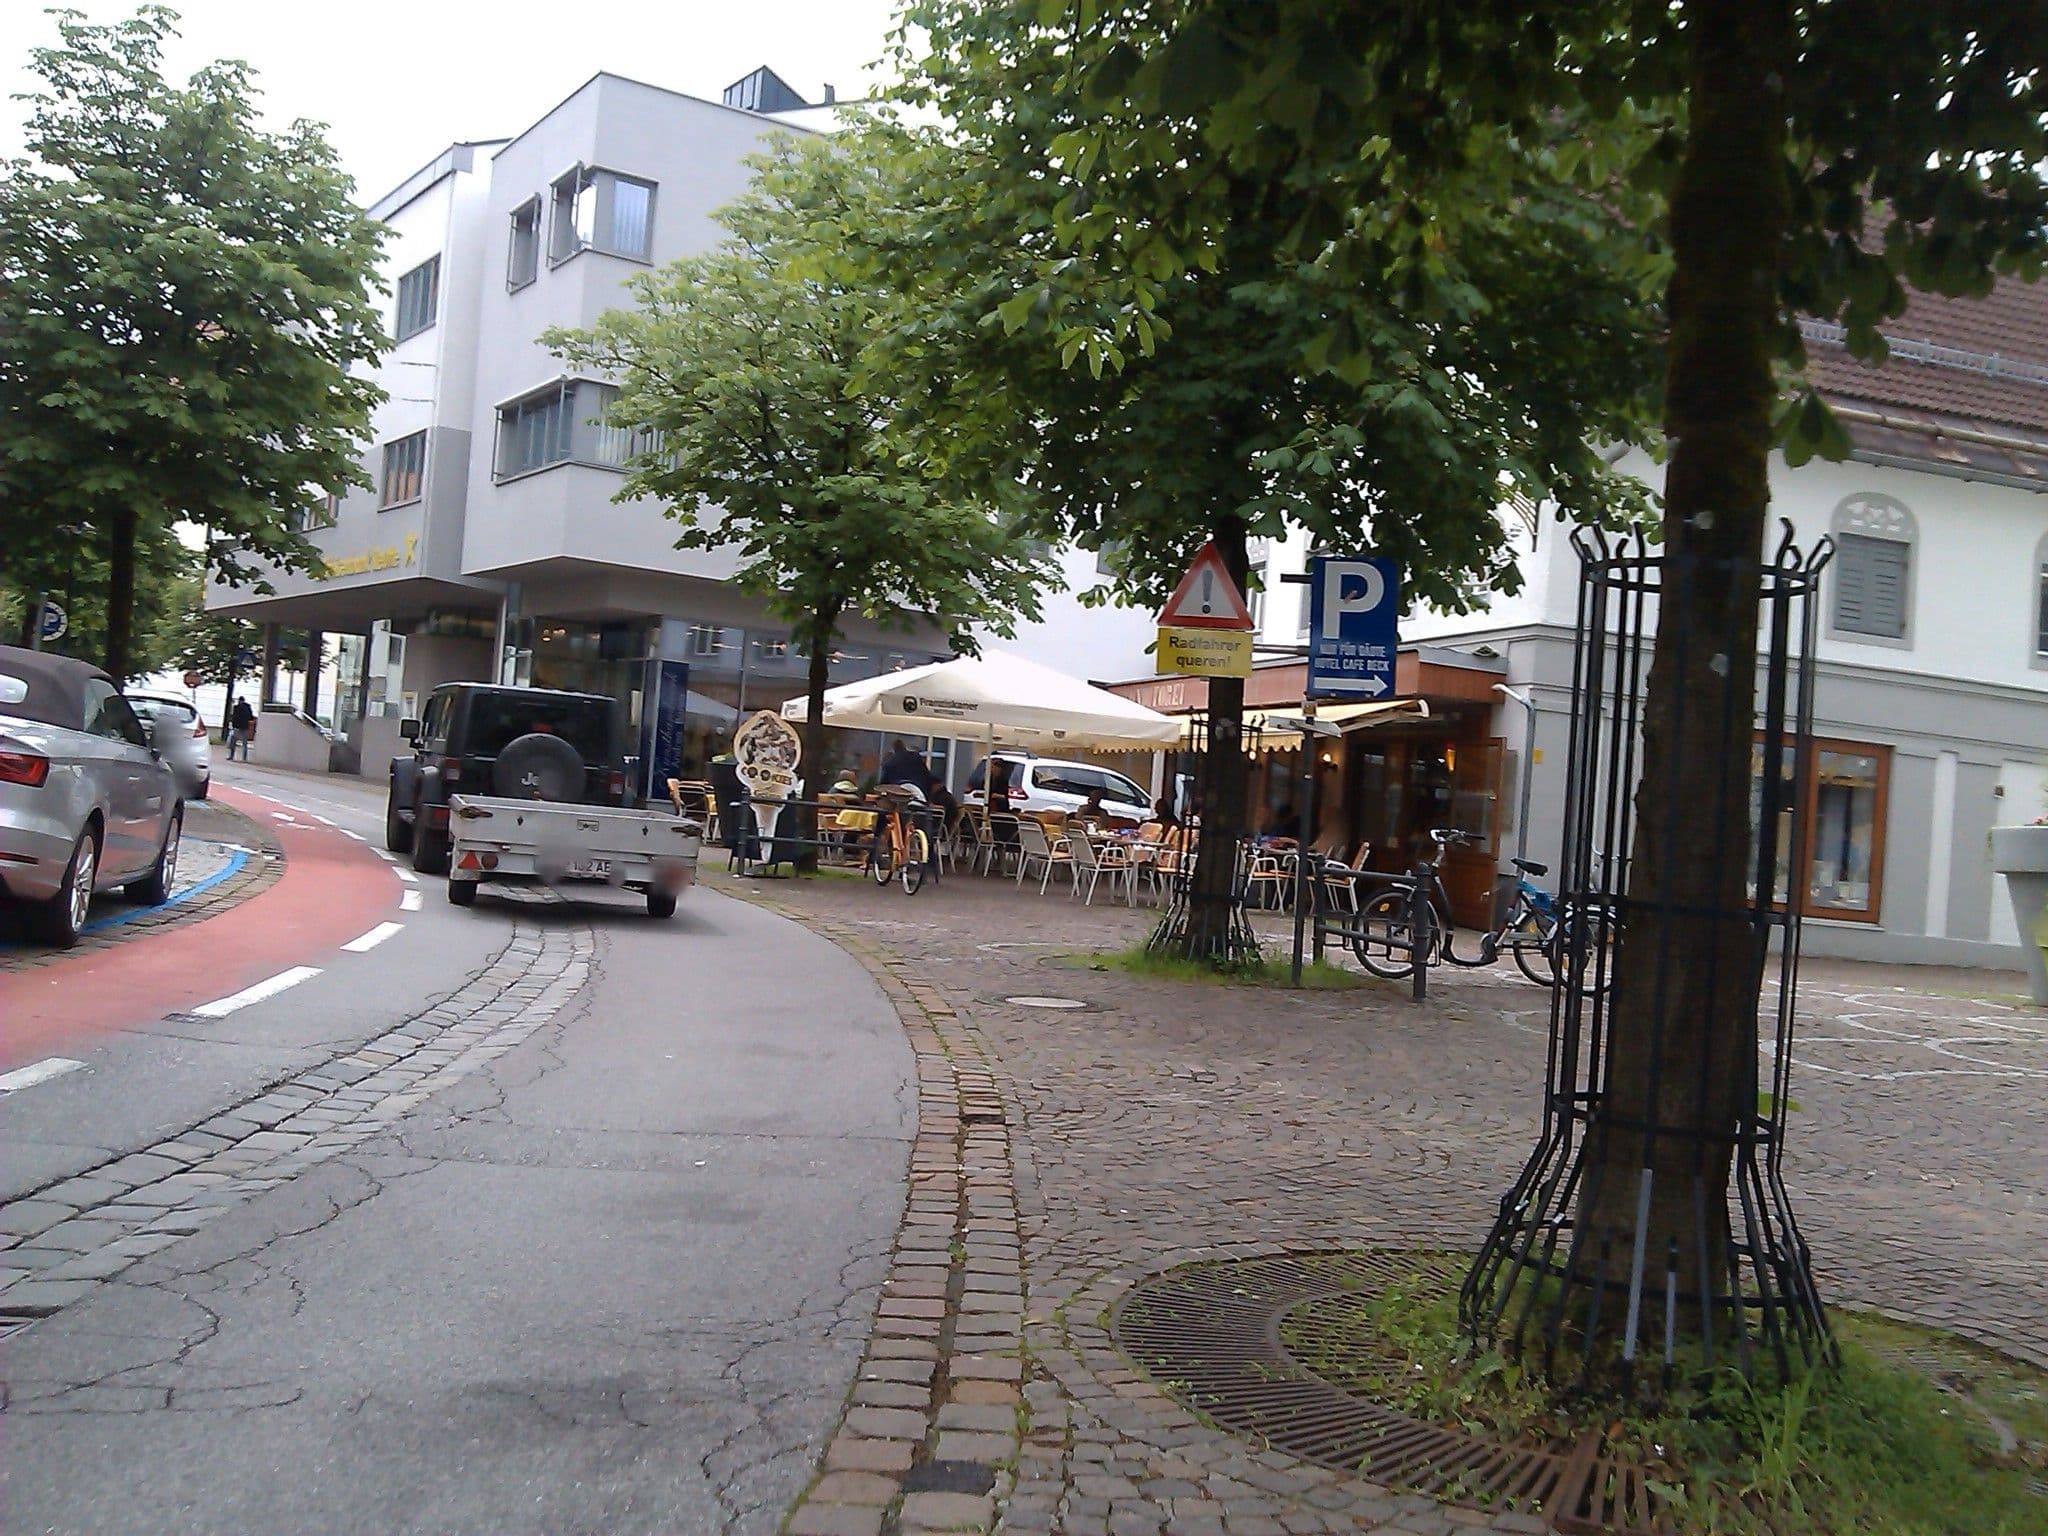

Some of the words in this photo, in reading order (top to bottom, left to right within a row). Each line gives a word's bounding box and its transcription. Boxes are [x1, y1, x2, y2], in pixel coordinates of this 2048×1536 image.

[1323, 561, 1384, 639] P
[1169, 636, 1241, 651] Radfahrer
[1339, 641, 1357, 656] FÜR
[1176, 656, 1231, 668] queren!
[1314, 658, 1340, 669] HOTEL
[1342, 659, 1364, 670] CAFE
[521, 772, 541, 786] Je
